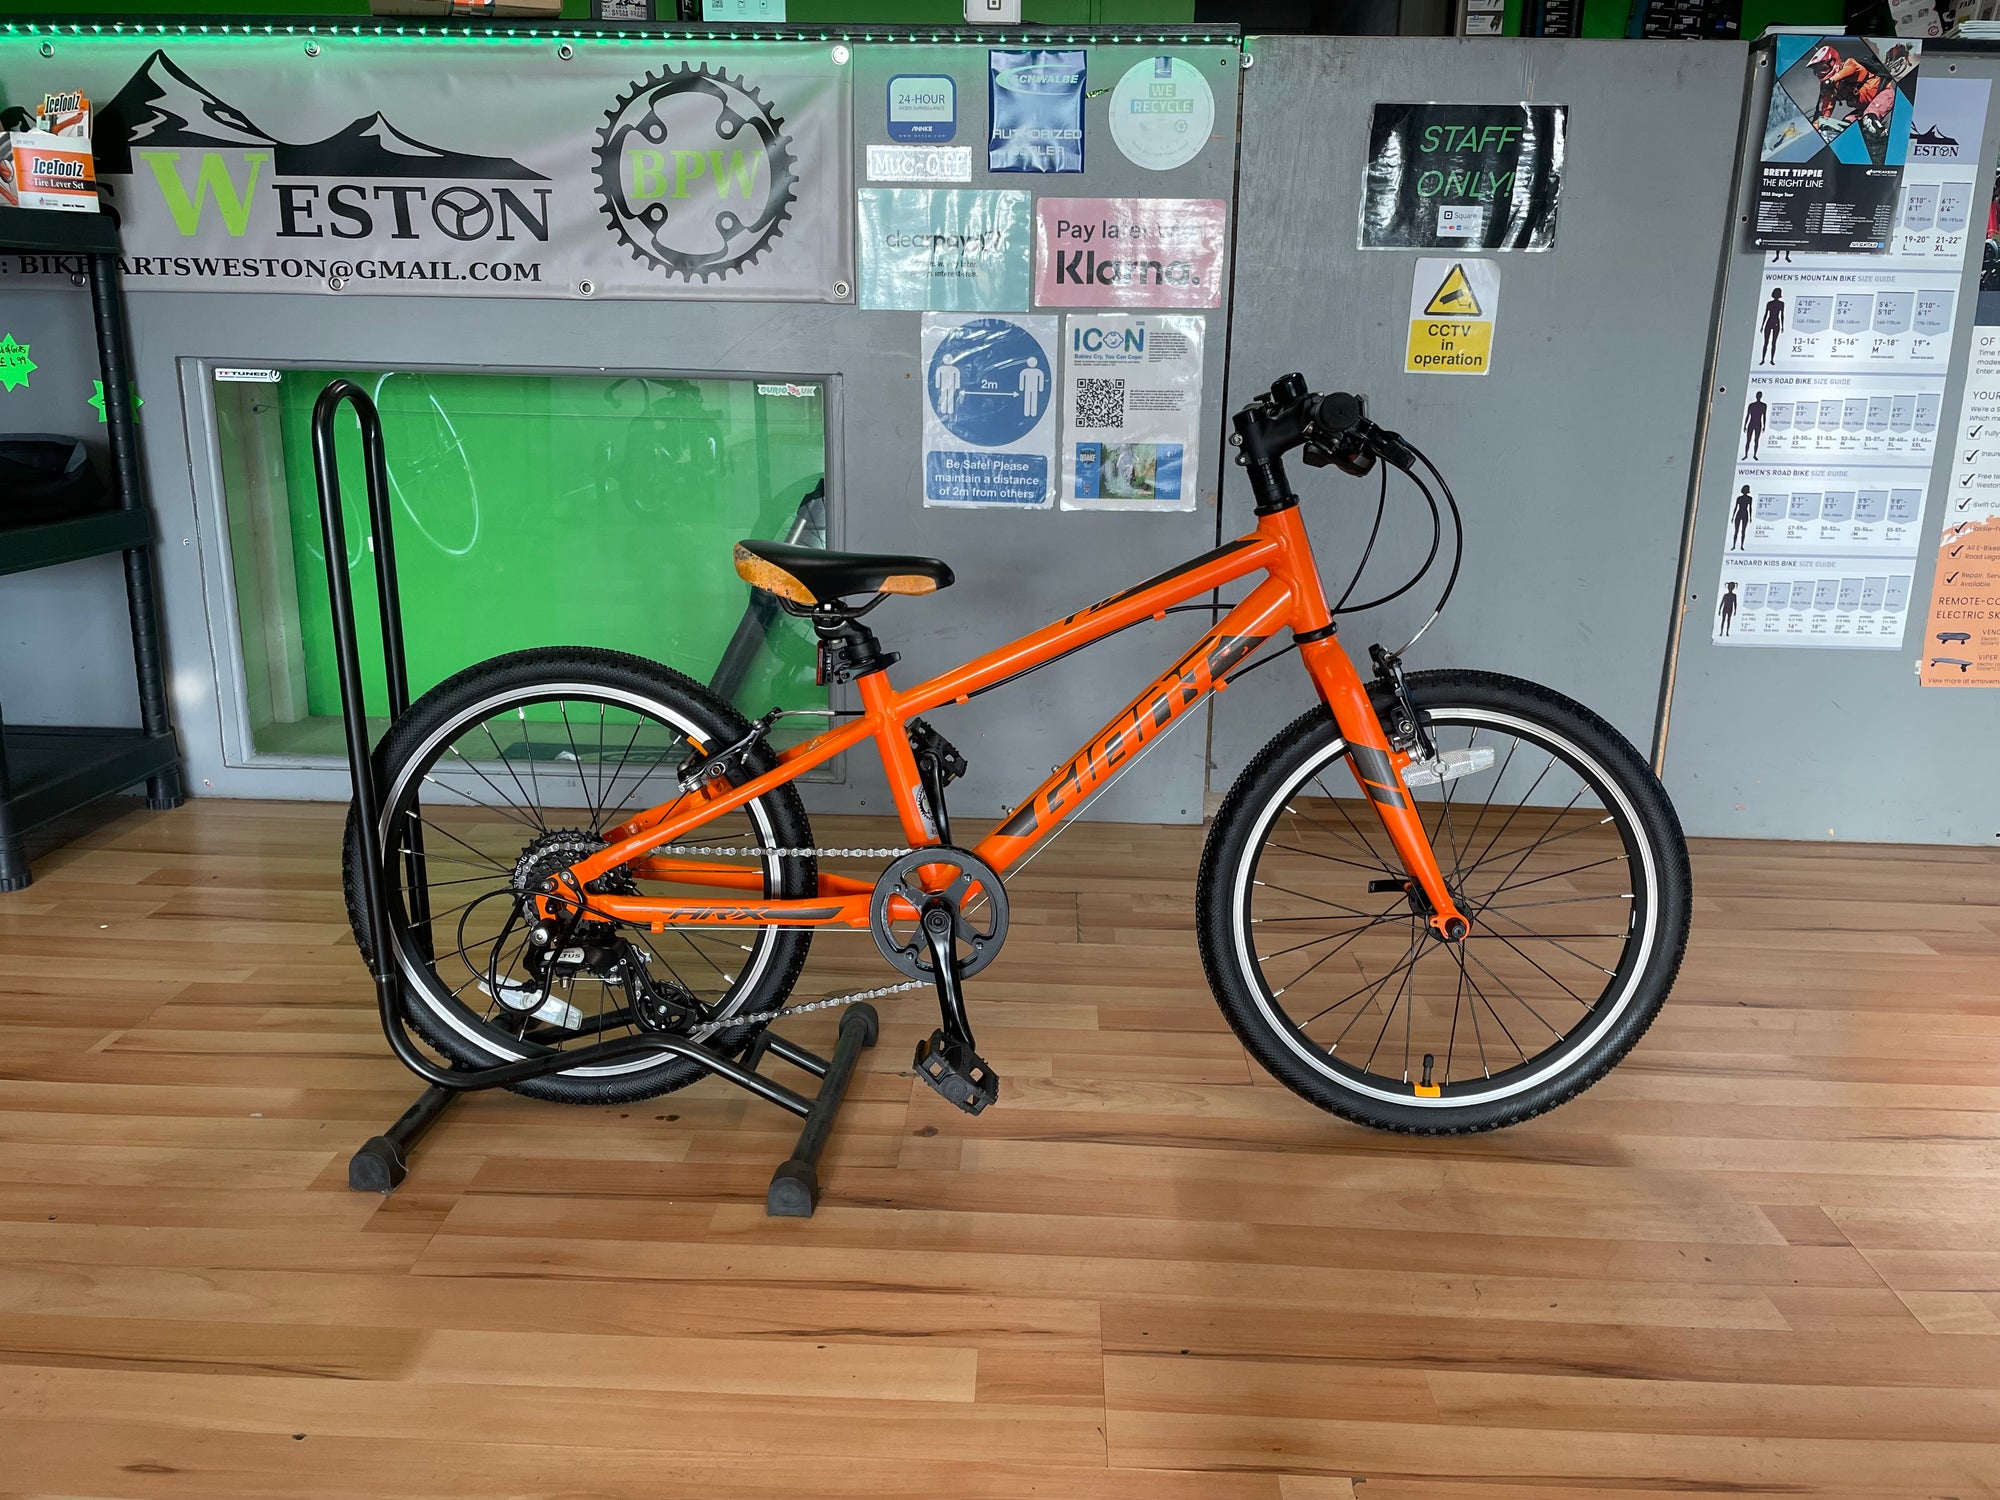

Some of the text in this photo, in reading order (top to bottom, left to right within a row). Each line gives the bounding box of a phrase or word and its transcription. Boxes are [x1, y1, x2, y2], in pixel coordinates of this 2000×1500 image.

[1151, 84, 1173, 97] WE
[45, 94, 80, 114] IceToolz
[899, 94, 945, 104] 24-HOUR
[1133, 100, 1191, 113] RECYCLE
[1420, 125, 1523, 153] STAFF
[1907, 142, 1960, 157] ESTON
[33, 157, 83, 177] IceToolz
[874, 153, 966, 176] Muc-Off
[628, 149, 763, 199] BPW
[1763, 168, 1823, 178] BRETT TIPPIE
[34, 178, 85, 190] Tire Lever Set
[1416, 170, 1516, 198] ONLY!
[1763, 178, 1824, 188] THE RIGHT LINE
[141, 152, 553, 242] WESTON
[1057, 220, 1096, 243] Pay
[886, 230, 971, 256] clearpay
[20, 255, 542, 282] BIKEARTSWESTON@GMAIL.COM
[1056, 250, 1201, 286] Klarna.
[1765, 274, 1800, 282] WOMEN'S
[1857, 275, 1873, 283] SIZE
[1874, 275, 1896, 283] GUIDE
[1428, 324, 1472, 337] CCTV
[1441, 339, 1454, 351] in
[1980, 337, 1996, 346] OF
[1414, 353, 1482, 368] operation
[981, 379, 998, 389] 2m
[946, 460, 1030, 471] Be Safe! Please
[935, 474, 981, 484] maintain
[993, 475, 1040, 485] distance
[1738, 469, 1772, 477] WOMEN'S
[1827, 470, 1848, 478] GUIDE
[939, 487, 1034, 499] of 2m from others
[1725, 559, 1763, 567] STANDARD
[1798, 560, 1814, 568] SIZE
[1815, 560, 1837, 568] GUIDE
[1936, 610, 1985, 619] ELECTRIC
